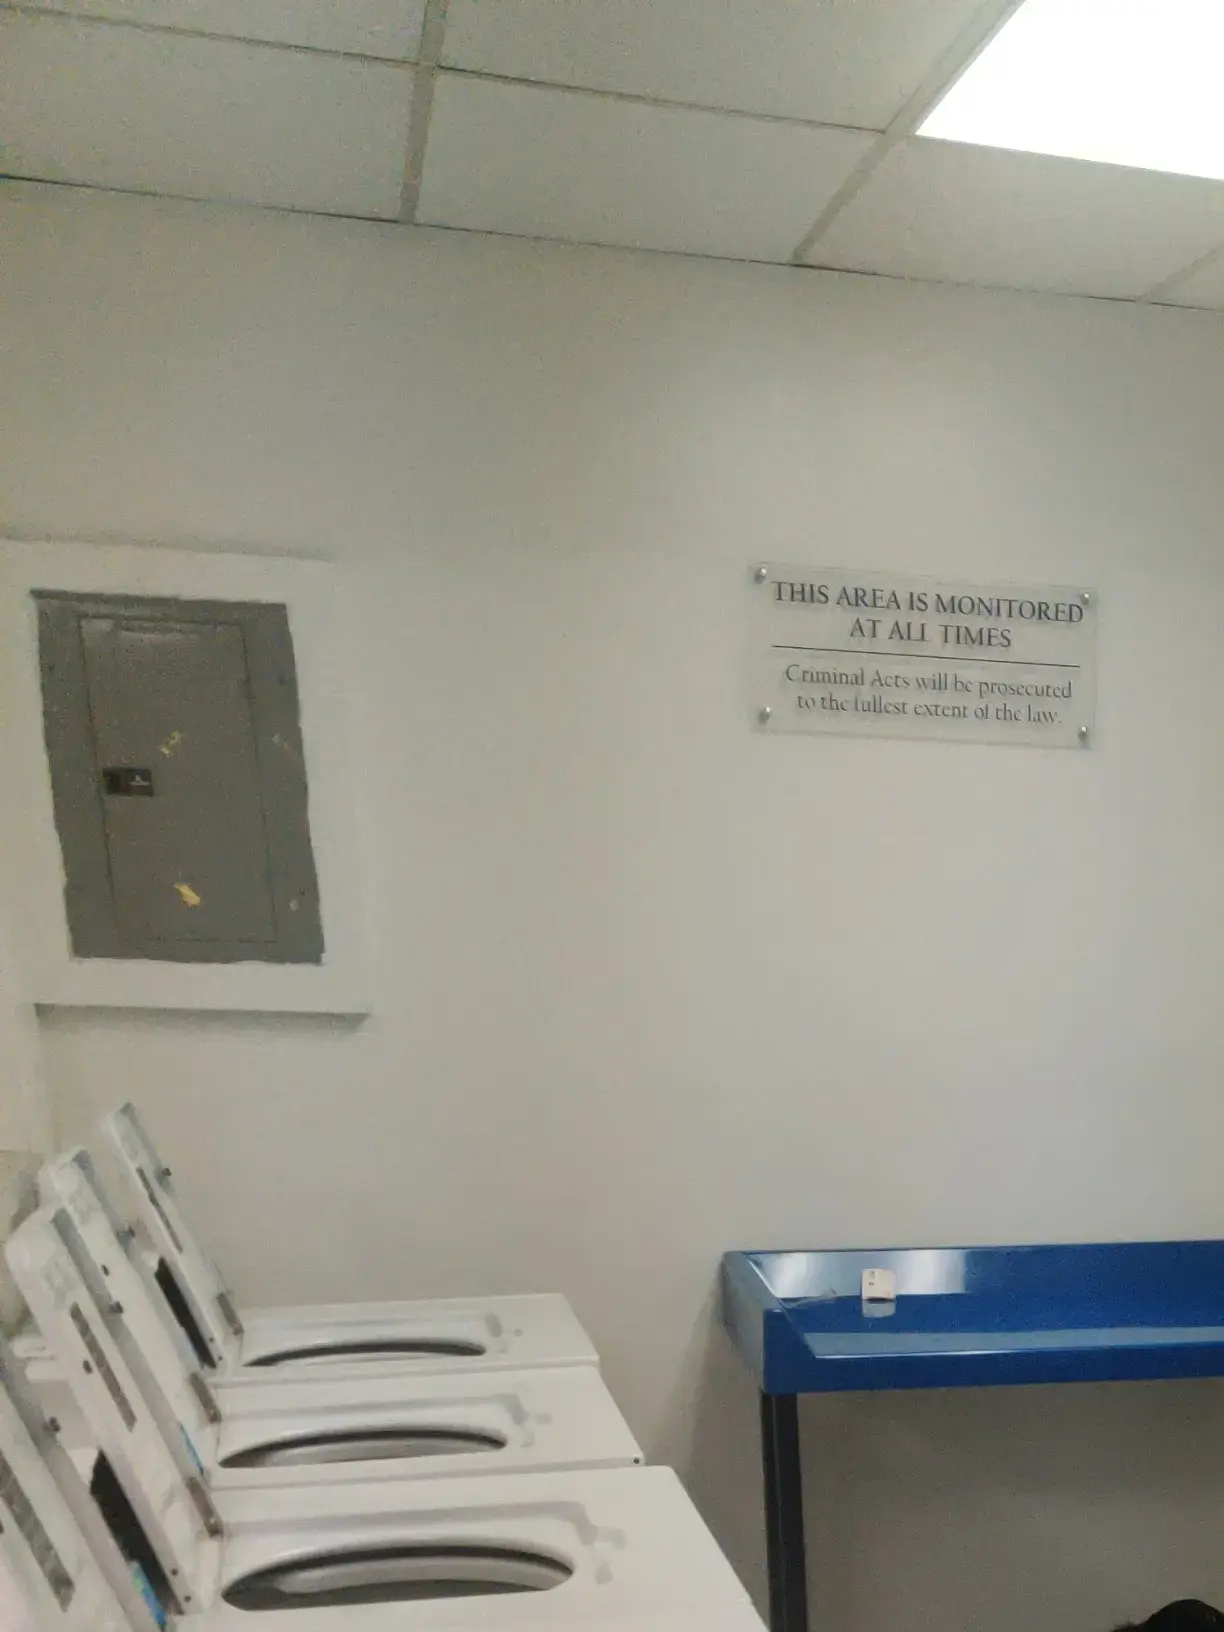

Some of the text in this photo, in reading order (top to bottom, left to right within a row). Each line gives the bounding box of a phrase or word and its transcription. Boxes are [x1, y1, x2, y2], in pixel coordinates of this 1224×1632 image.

[771, 581, 1084, 623] THIS AREA IS MONITORED
[850, 617, 1012, 648] AT ALL TIMES
[785, 664, 1073, 699] Criminal Acts will be prosecuted
[797, 693, 1063, 724] to the fullest extent of the law.
